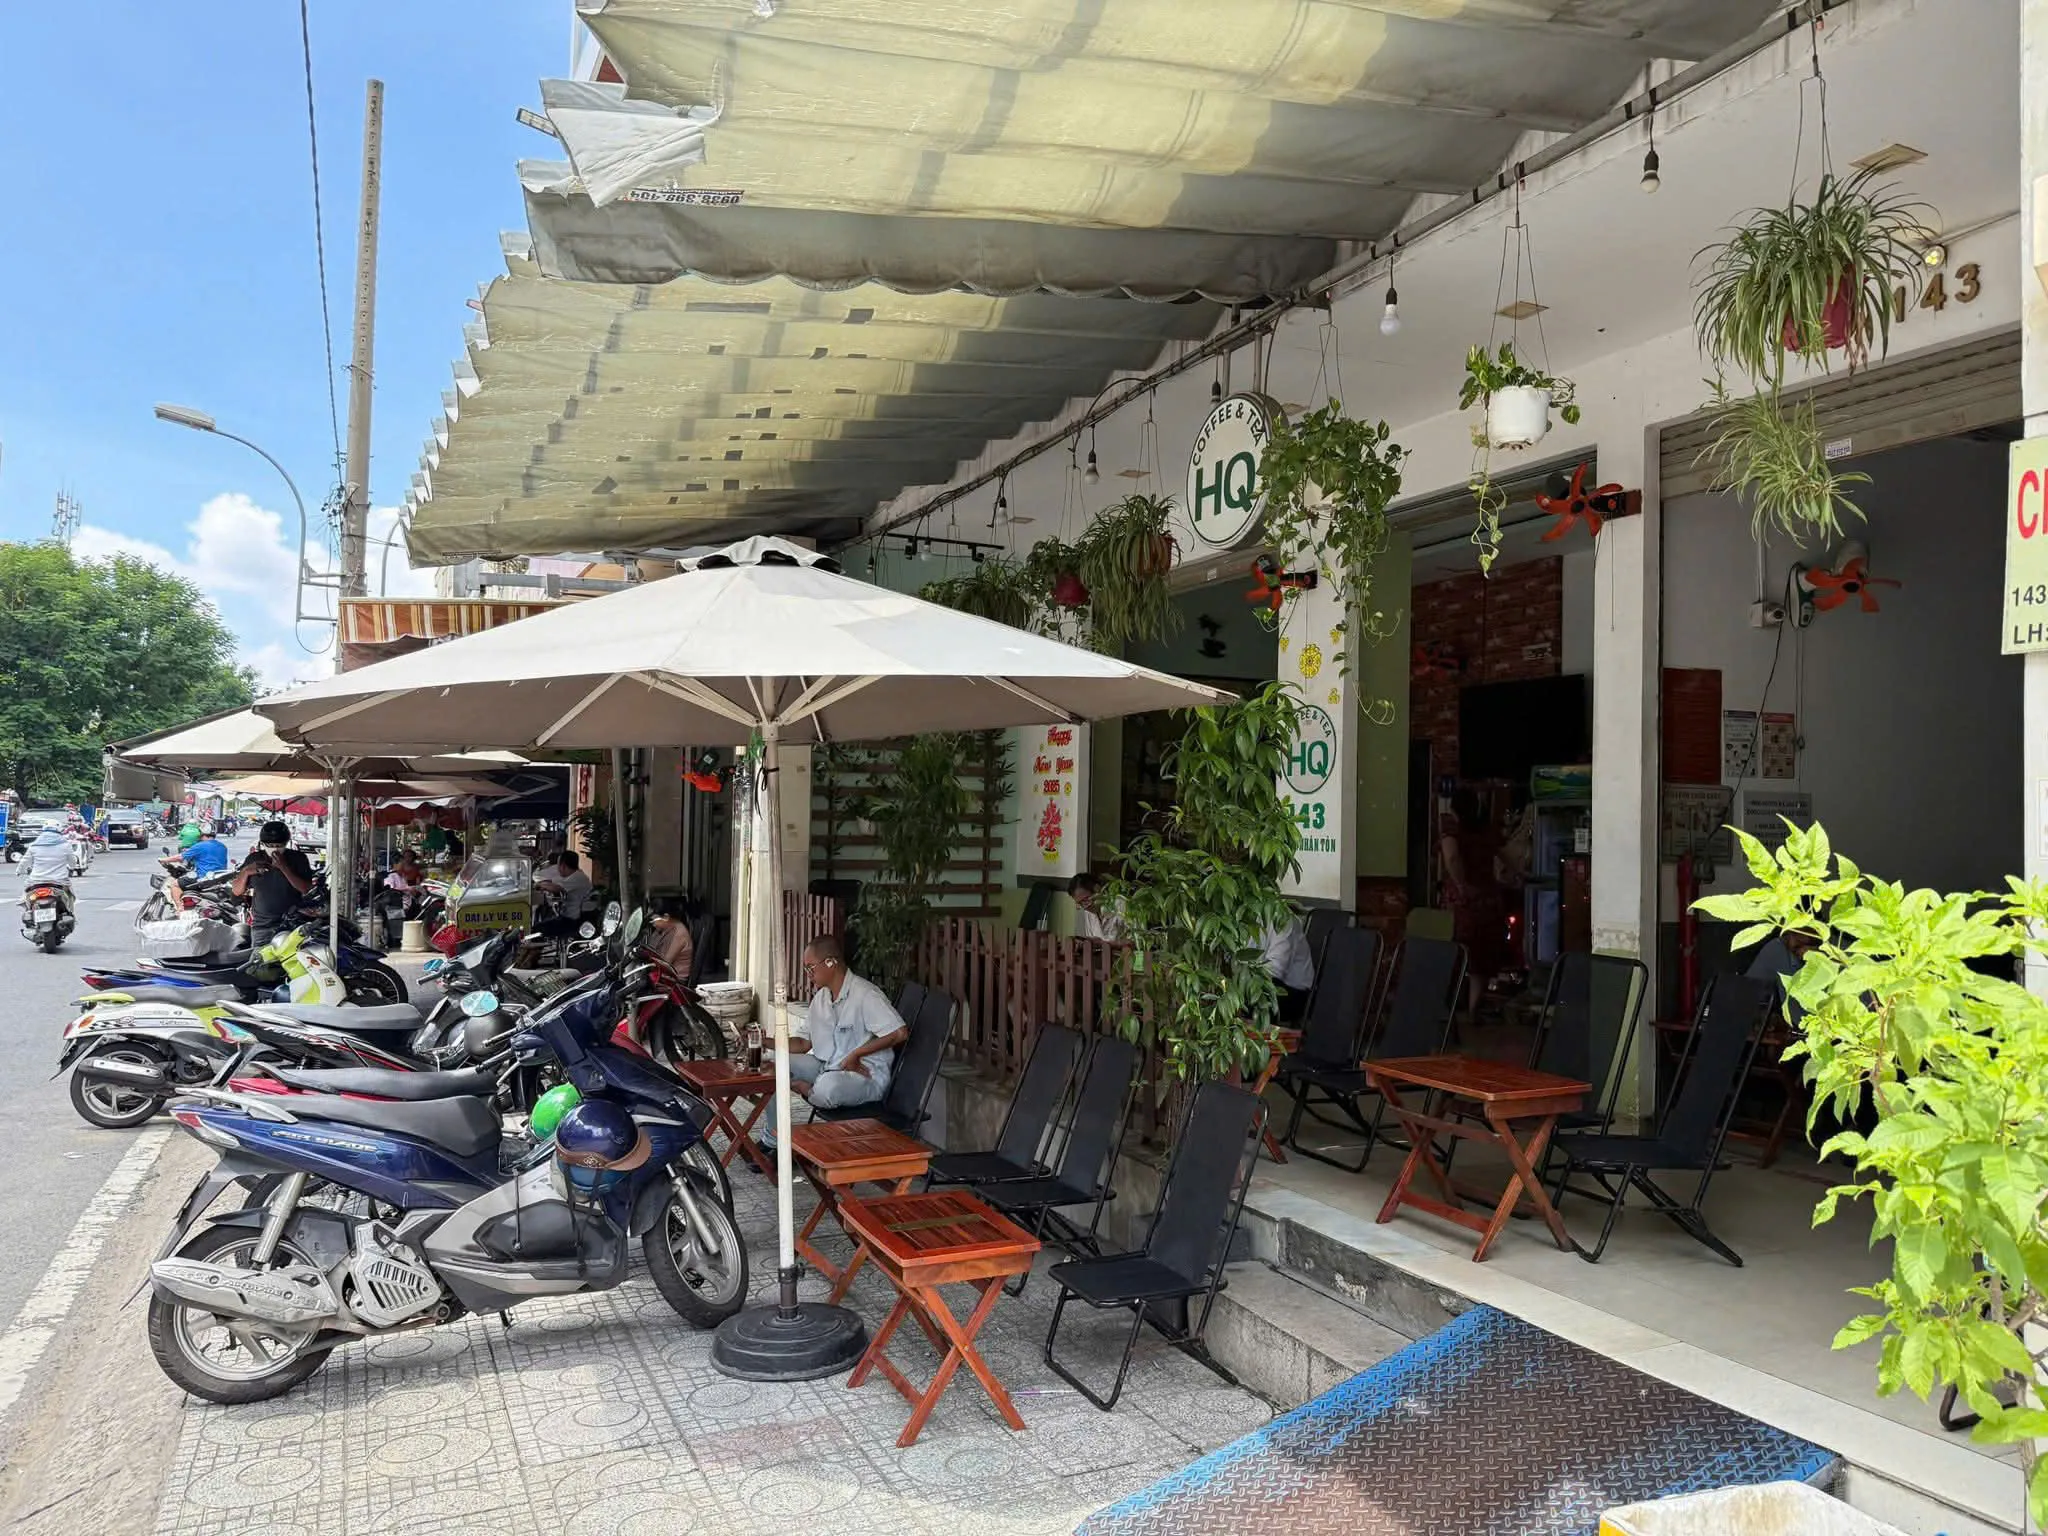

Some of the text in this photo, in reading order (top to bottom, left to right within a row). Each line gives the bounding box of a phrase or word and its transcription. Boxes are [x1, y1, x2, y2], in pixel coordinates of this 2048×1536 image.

[1893, 262, 1982, 324] 143
[1193, 402, 1264, 467] COFFEE & TEA
[1194, 451, 1256, 522] HQ
[2012, 584, 2047, 608] 143
[1047, 726, 1072, 747] Happy
[1319, 715, 1332, 738] TEA
[1033, 756, 1074, 775] New Year
[1287, 740, 1329, 778] HQ
[1043, 780, 1060, 794] 2025
